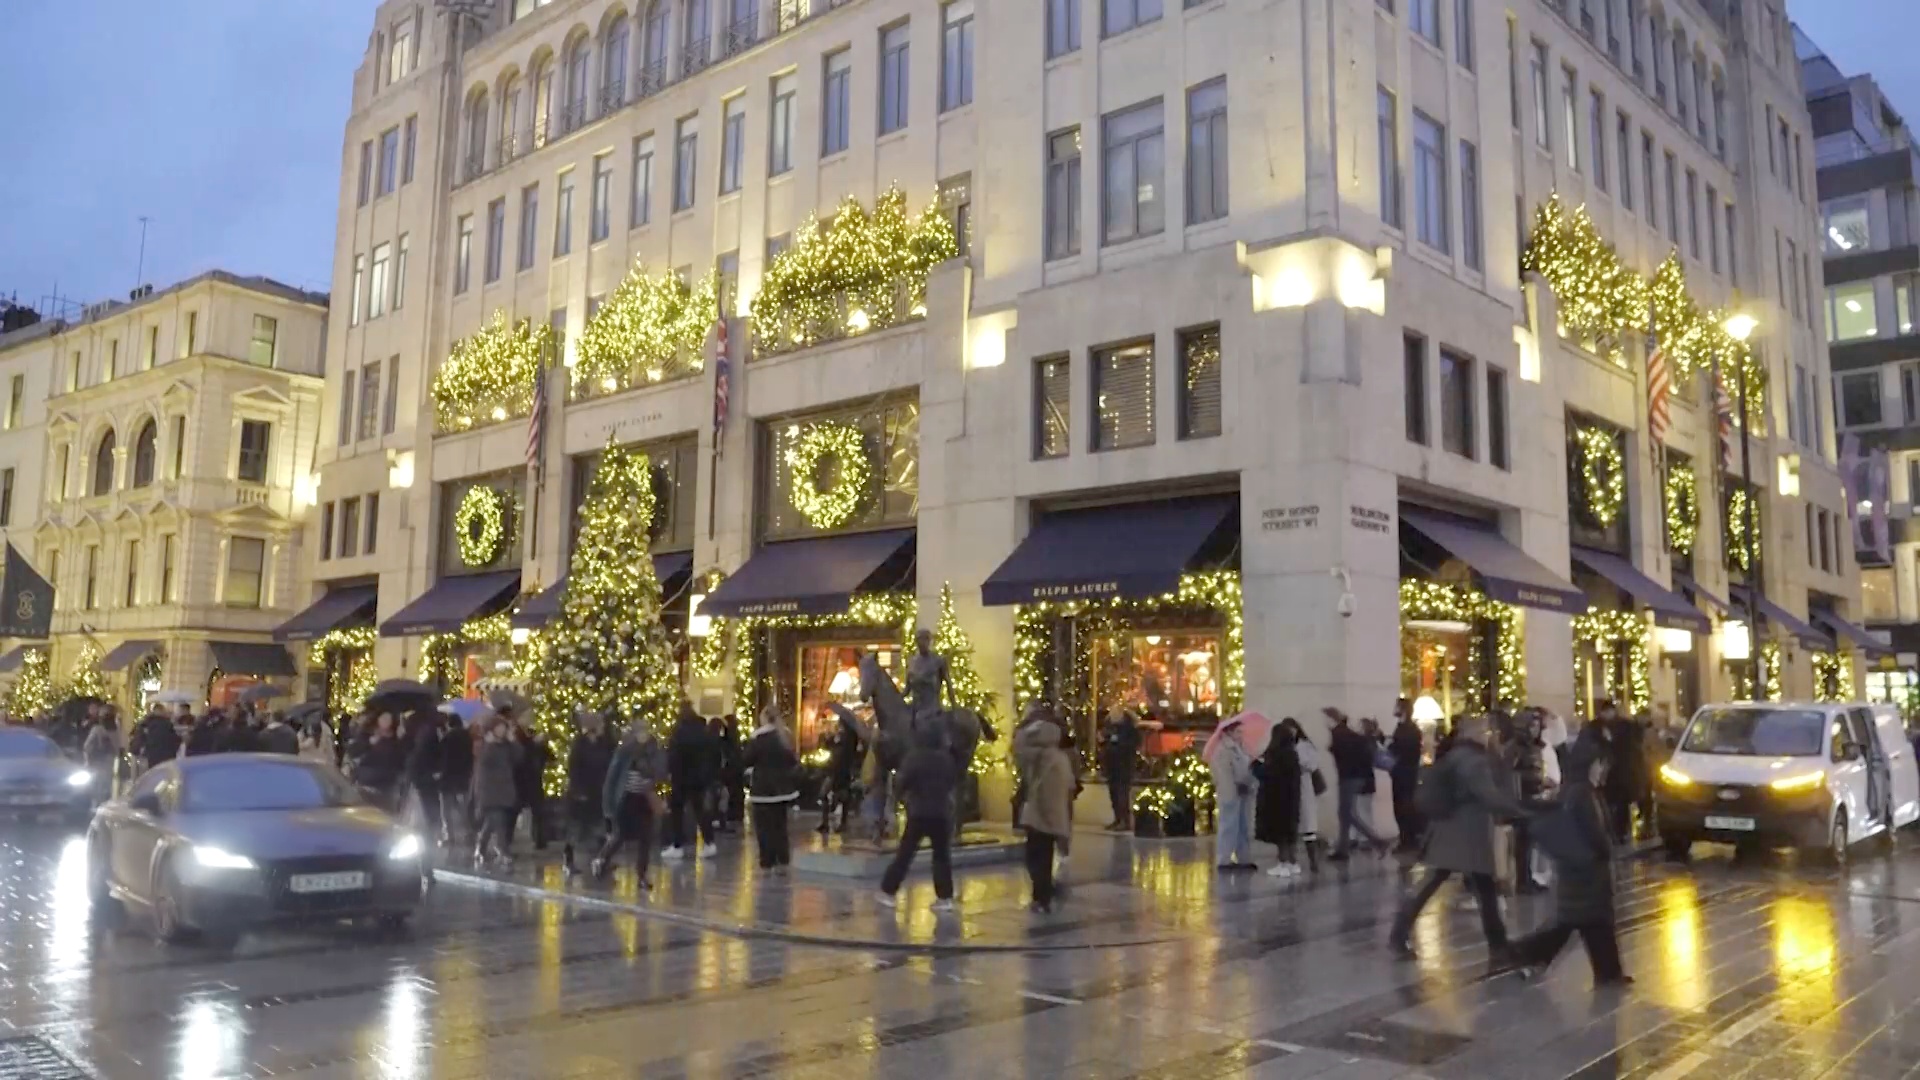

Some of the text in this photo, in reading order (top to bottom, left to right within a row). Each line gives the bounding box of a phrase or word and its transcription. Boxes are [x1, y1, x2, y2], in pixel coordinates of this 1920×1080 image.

[1262, 505, 1319, 519] NEW BOND
[1262, 519, 1299, 530] STREET
[1033, 582, 1117, 597] RALPH LAUREN
[739, 602, 798, 613] RALPH LAUREN
